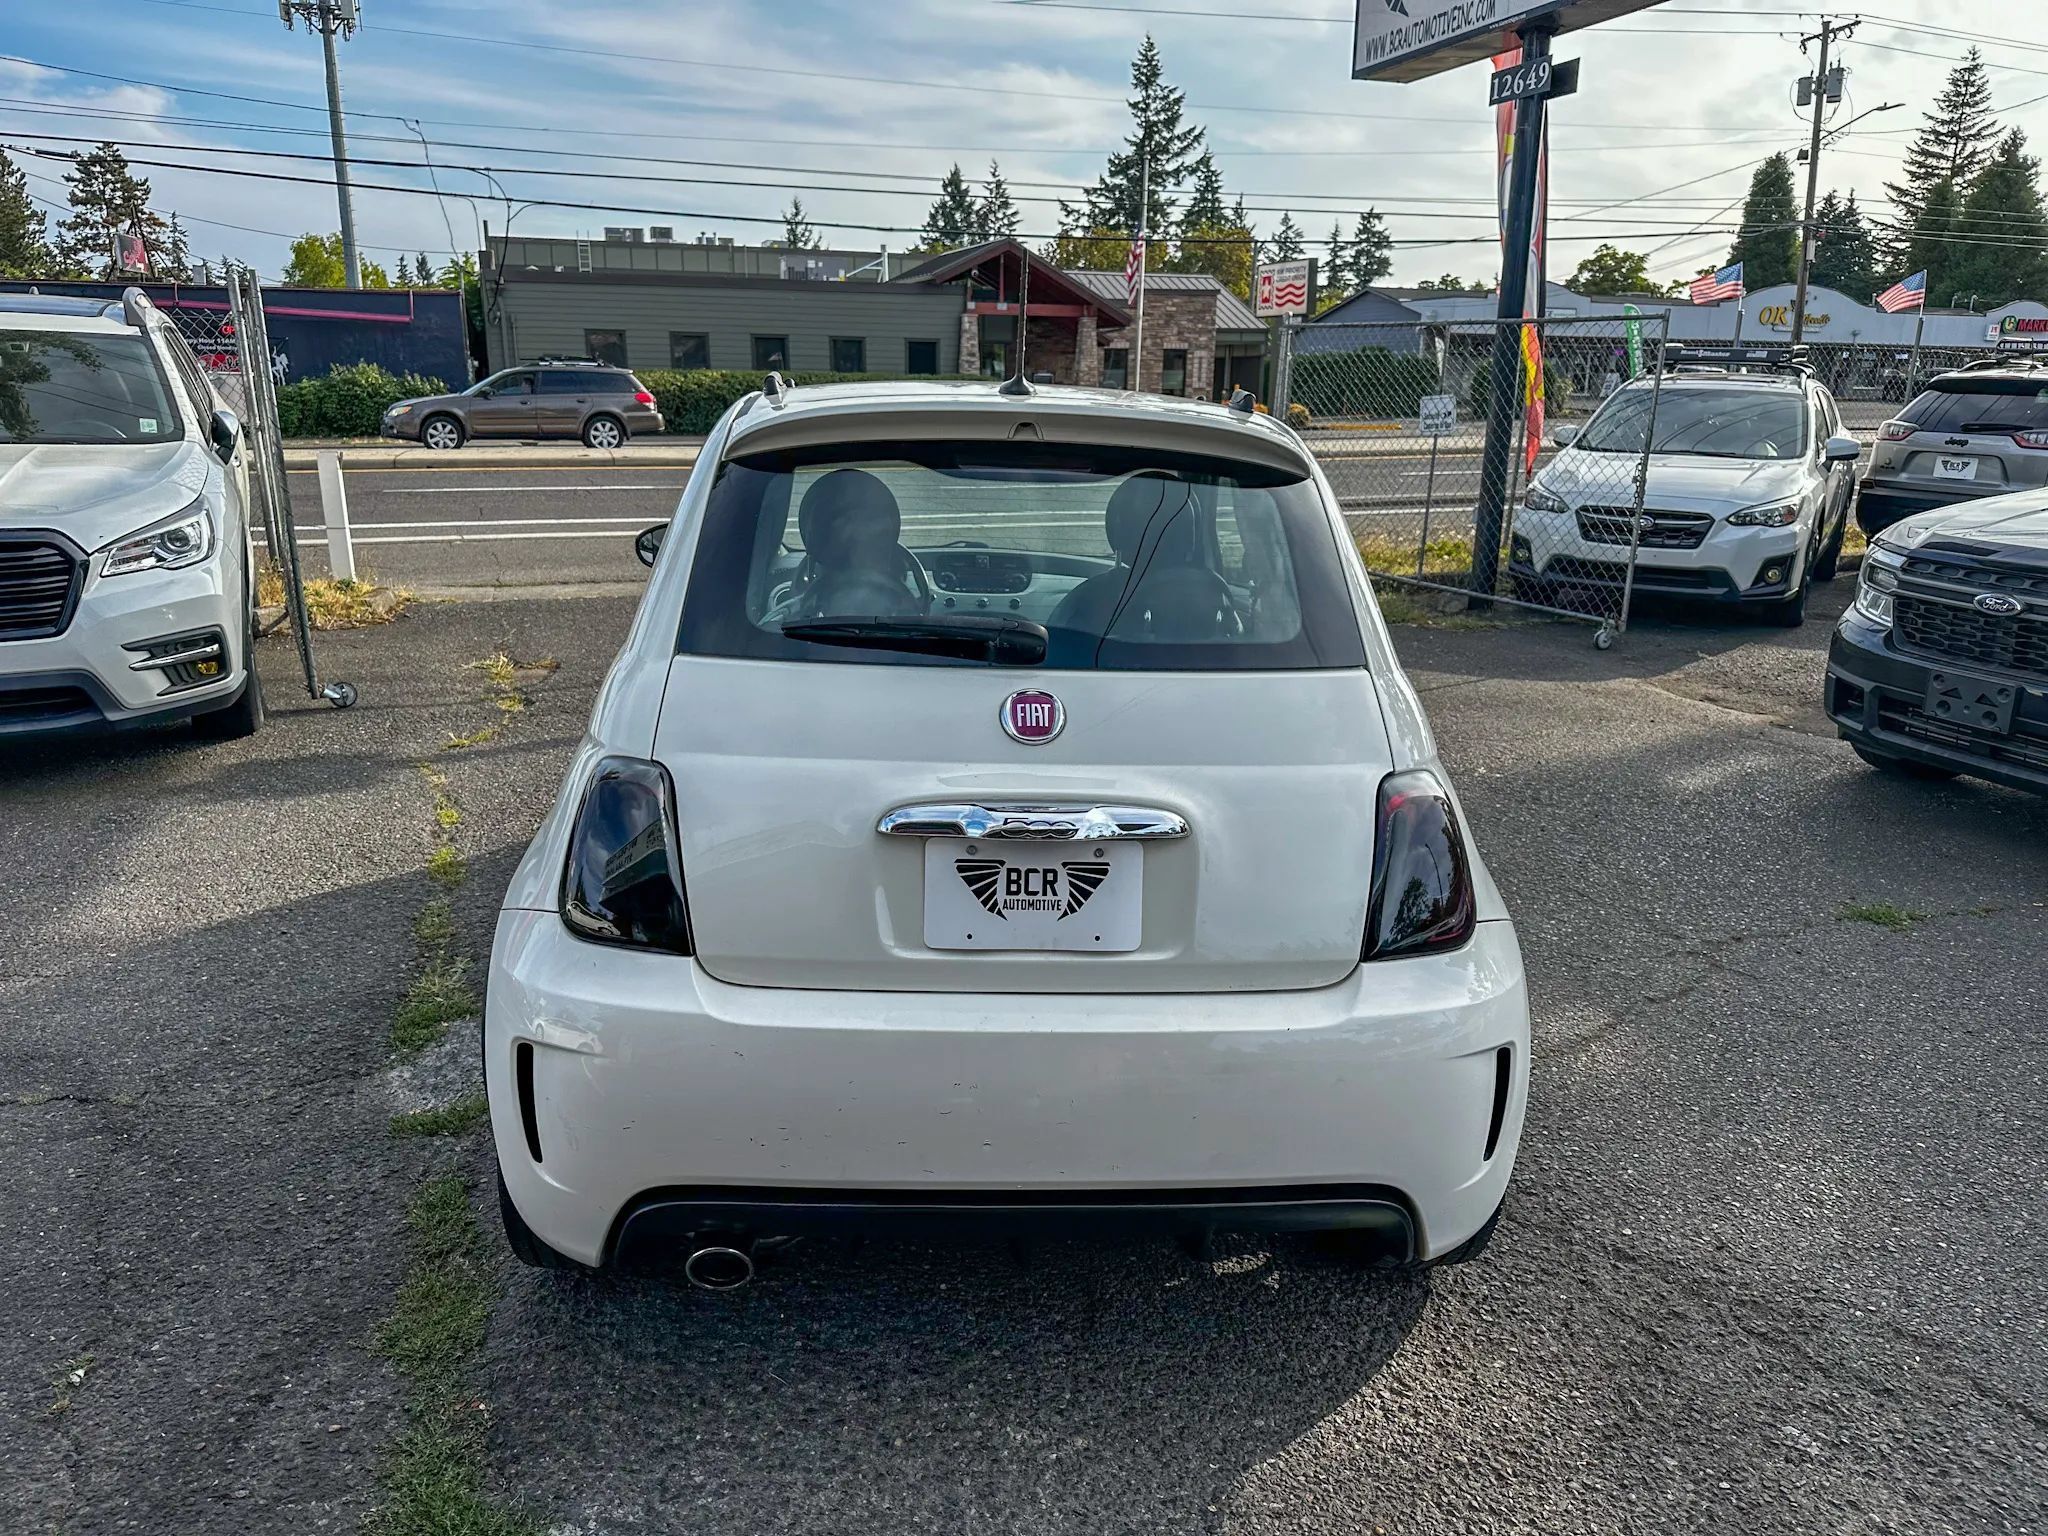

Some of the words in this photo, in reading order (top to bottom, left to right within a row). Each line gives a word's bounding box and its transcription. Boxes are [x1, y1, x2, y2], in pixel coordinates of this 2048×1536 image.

[1365, 0, 1496, 63] WWW.BCRAUTOMOTIVEINC.COM
[1491, 61, 1549, 101] 12649
[1759, 305, 1788, 326] OK
[1944, 436, 1969, 448] Jeep
[1982, 597, 2008, 612] Ford
[1015, 702, 1052, 727] FIAT
[1005, 867, 1060, 897] BCR
[1002, 898, 1063, 912] AUTOMOTIVE
